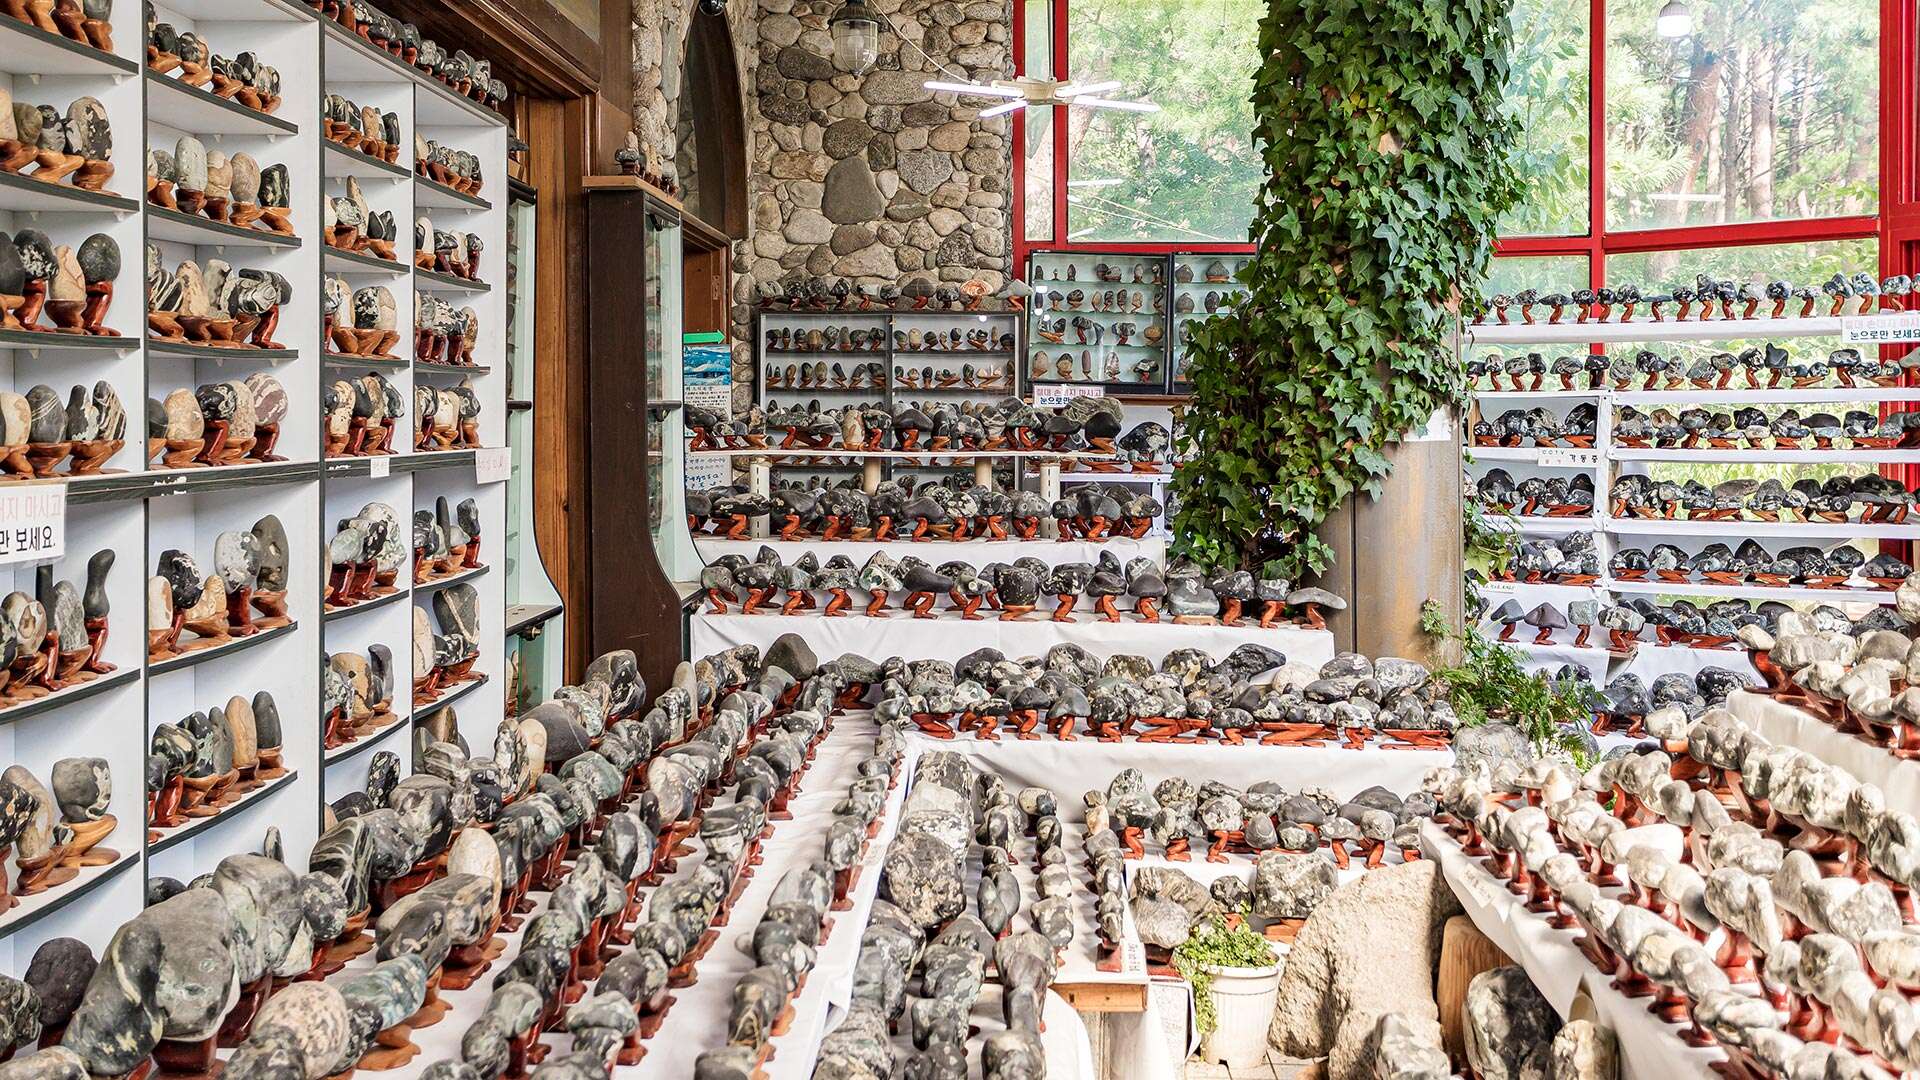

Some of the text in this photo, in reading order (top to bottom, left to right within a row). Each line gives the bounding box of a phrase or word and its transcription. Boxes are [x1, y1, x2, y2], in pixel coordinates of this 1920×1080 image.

[1850, 328, 1920, 341] 눈으로만 보세요
[25, 493, 61, 520] 마시고
[16, 525, 56, 552] 보세요.
